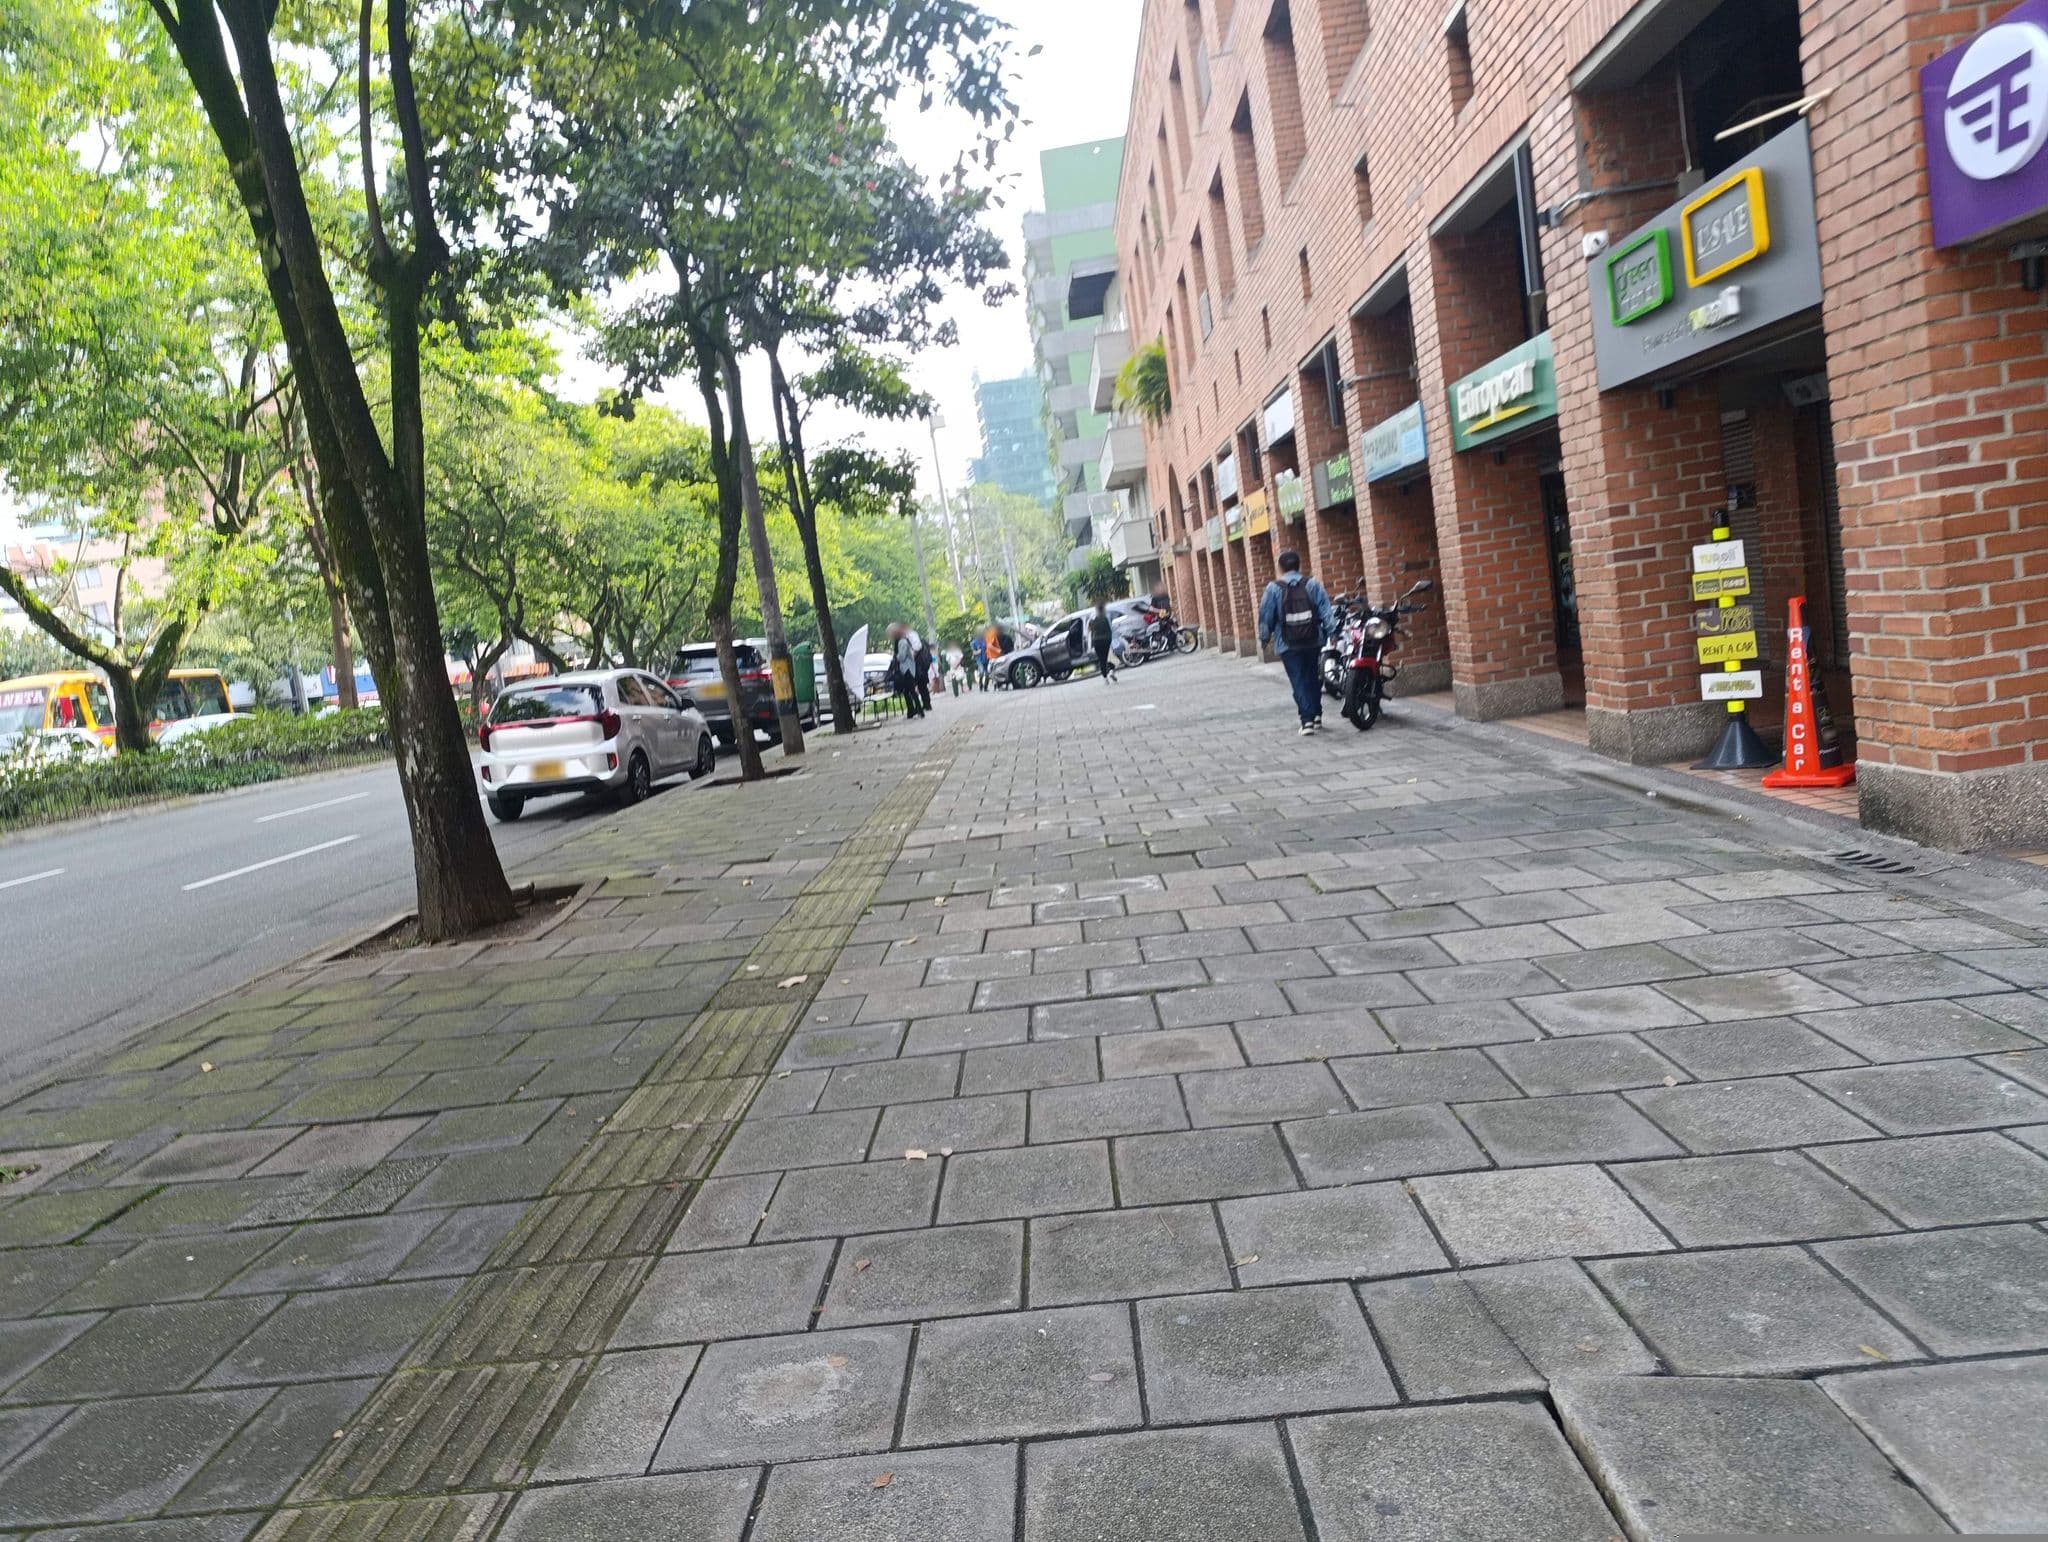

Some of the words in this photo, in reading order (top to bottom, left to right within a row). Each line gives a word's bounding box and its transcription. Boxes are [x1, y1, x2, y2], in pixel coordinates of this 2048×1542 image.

[1457, 358, 1537, 423] Europcar
[1703, 644, 1724, 656] RENT
[1728, 644, 1734, 654] A
[1789, 627, 1804, 691] Rent
[1792, 702, 1803, 713] a
[1791, 723, 1805, 771] Car
